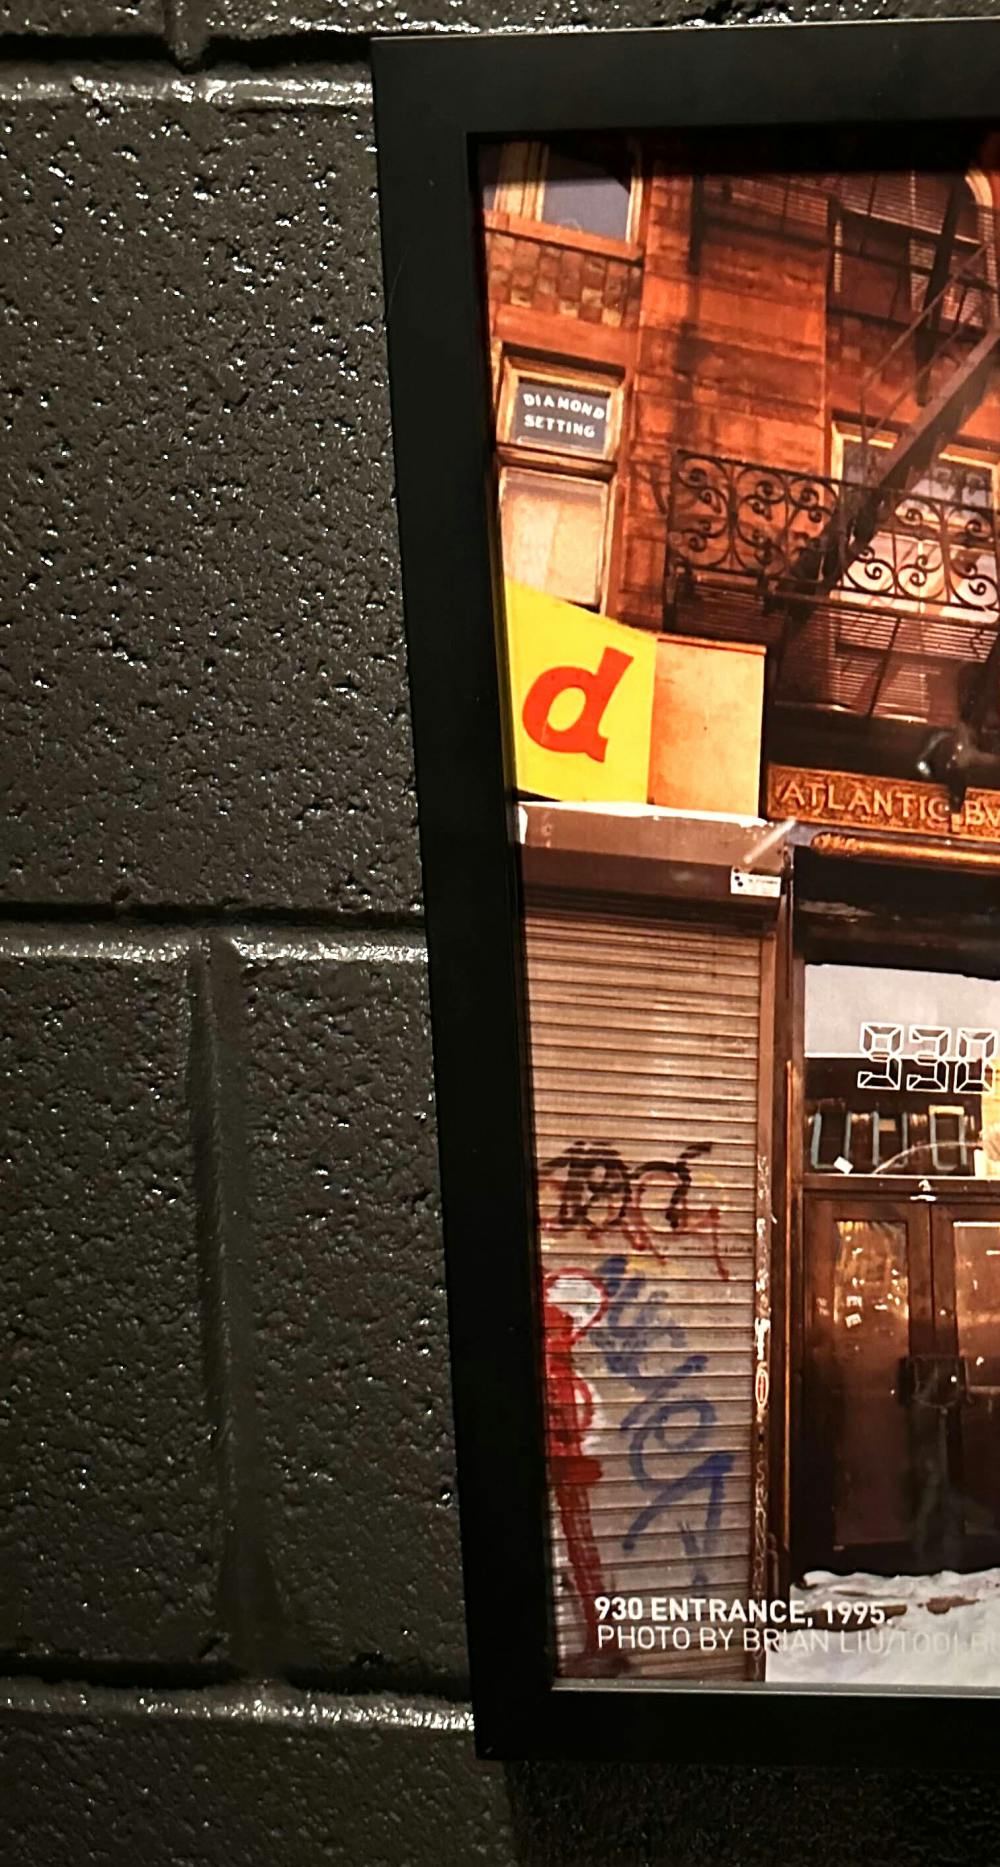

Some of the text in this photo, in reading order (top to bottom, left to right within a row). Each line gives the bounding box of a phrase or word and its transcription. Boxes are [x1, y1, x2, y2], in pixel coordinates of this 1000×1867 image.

[522, 392, 606, 420] DIAMOND
[523, 413, 596, 439] SETTING
[780, 781, 949, 824] ATLANTIC
[857, 1022, 998, 1096] 930
[594, 1597, 893, 1628] 930 ENTRANCE, 1995.
[597, 1625, 690, 1650] PHOTO
[699, 1628, 734, 1651] BY
[742, 1628, 829, 1653] BRIAN
